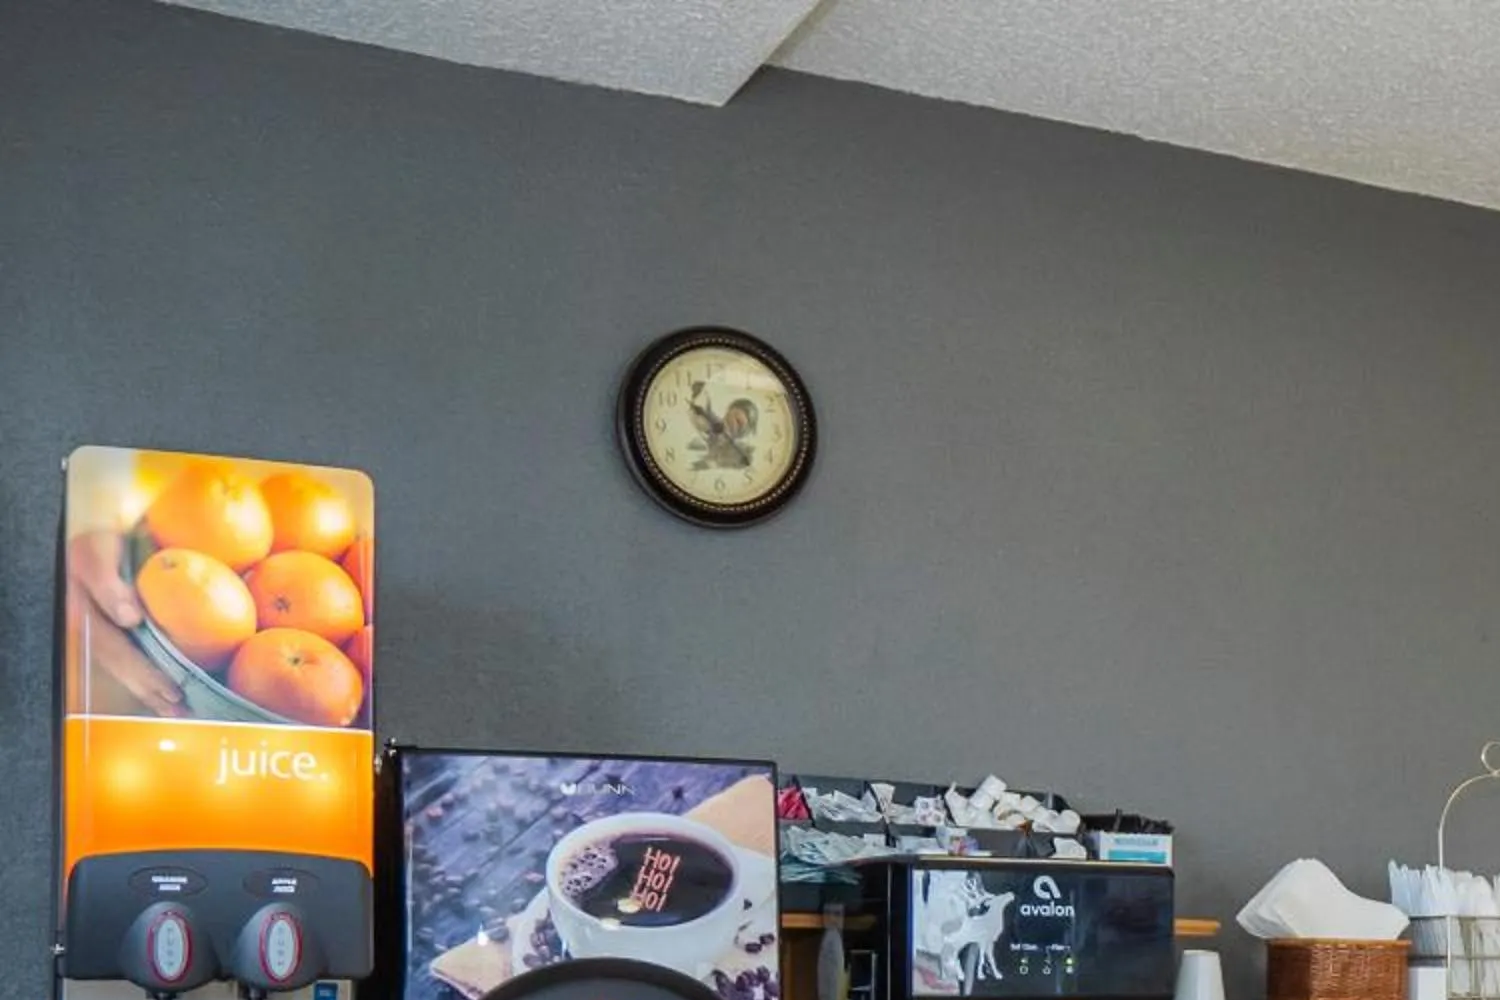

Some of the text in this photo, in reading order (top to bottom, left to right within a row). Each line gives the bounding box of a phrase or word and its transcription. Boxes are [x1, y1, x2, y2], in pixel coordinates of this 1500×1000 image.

[658, 391, 678, 408] 10
[216, 737, 329, 785] juice.
[1020, 901, 1075, 917] avalon
